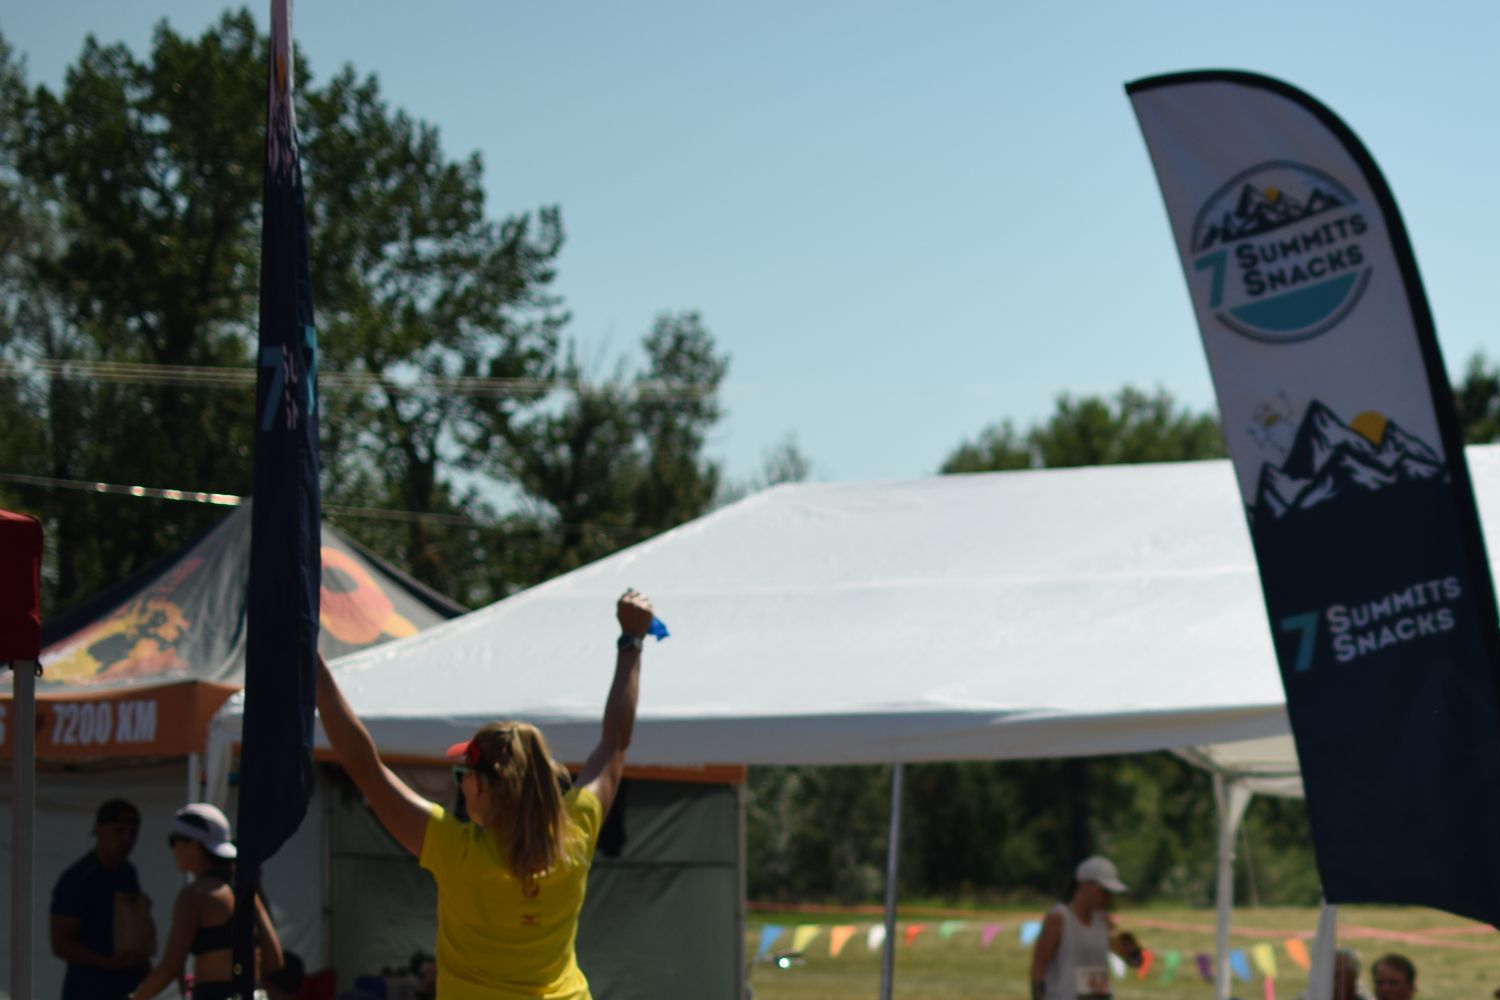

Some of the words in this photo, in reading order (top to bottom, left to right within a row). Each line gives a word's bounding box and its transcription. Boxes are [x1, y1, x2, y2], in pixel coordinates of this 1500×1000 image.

[1194, 249, 1228, 308] 7
[1280, 611, 1319, 672] 7
[53, 701, 112, 745] 7200
[116, 700, 157, 742] KM
